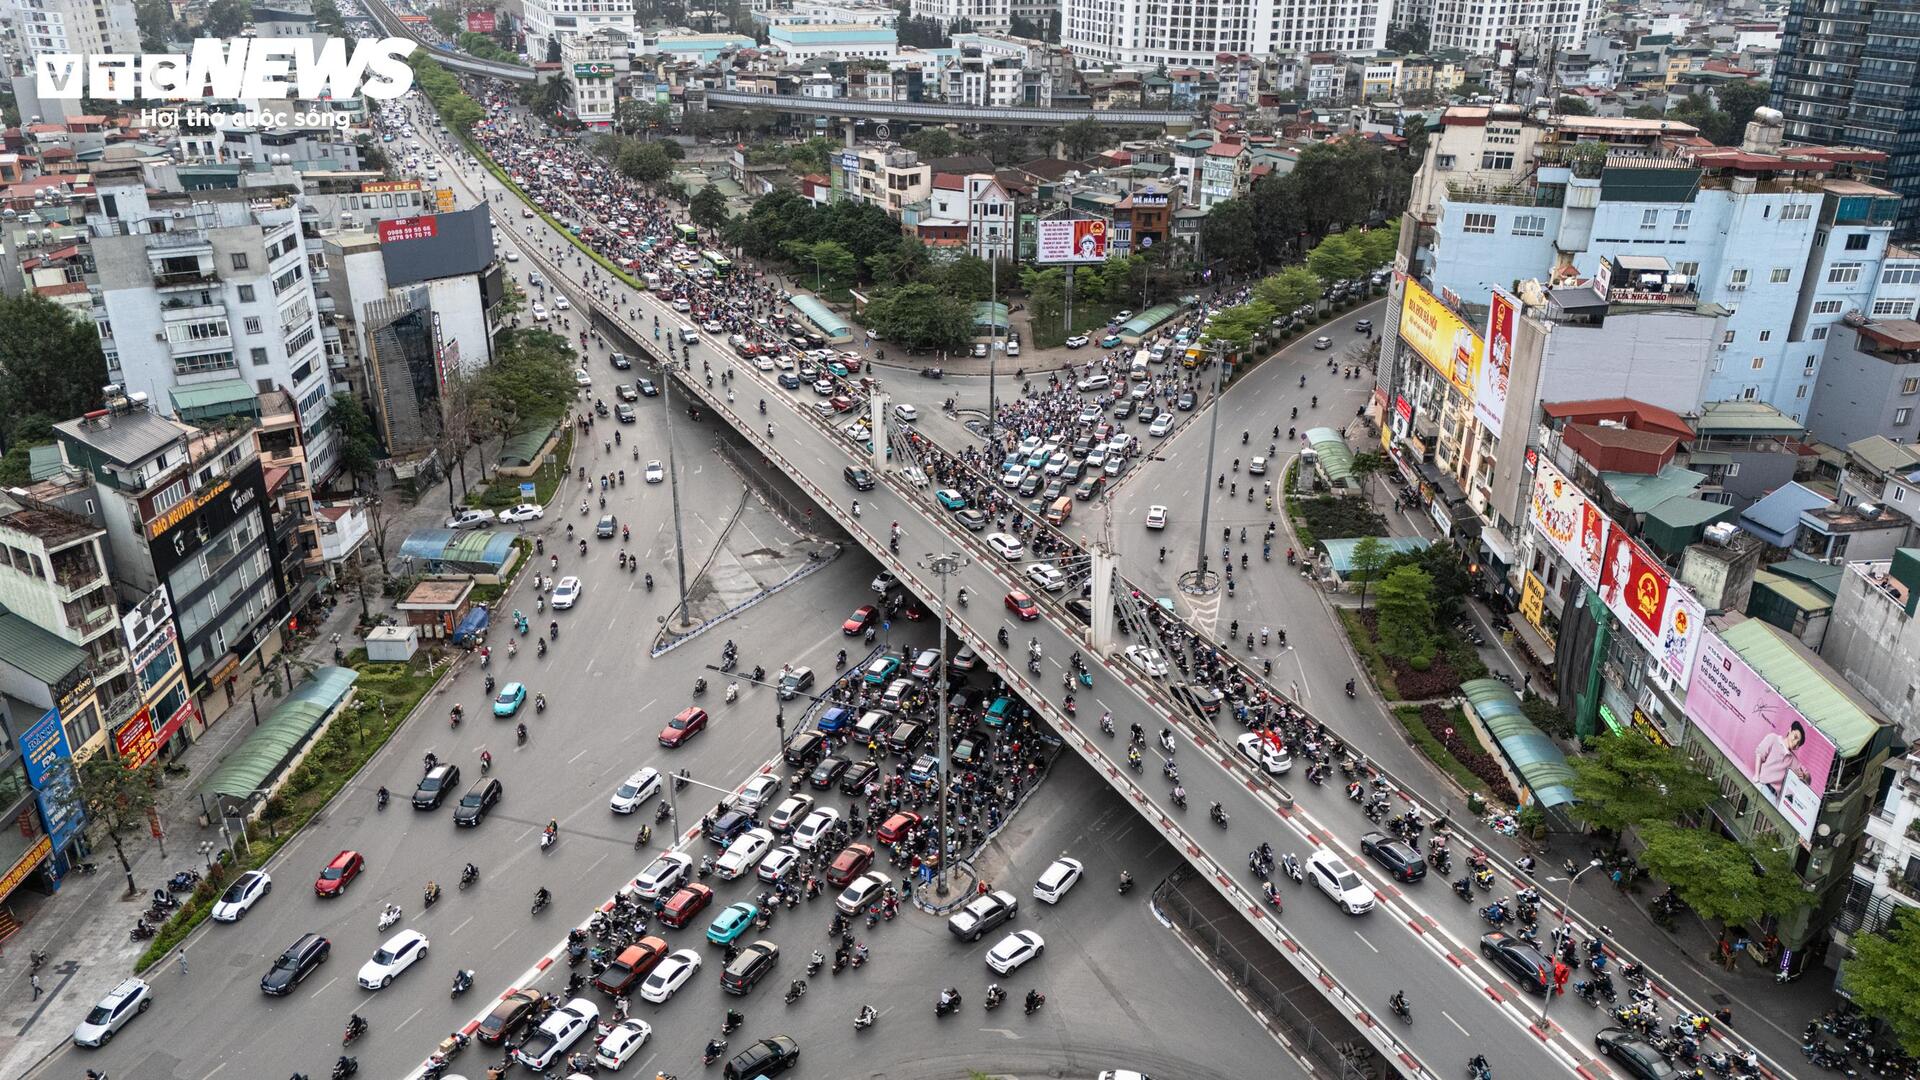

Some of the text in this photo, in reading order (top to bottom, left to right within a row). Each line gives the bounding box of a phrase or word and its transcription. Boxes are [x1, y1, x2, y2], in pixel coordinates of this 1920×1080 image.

[1488, 136, 1515, 144] HOTEL
[365, 185, 391, 193] HUY
[197, 480, 231, 507] Coffee
[1708, 673, 1717, 685] sau
[1720, 672, 1729, 684] rau
